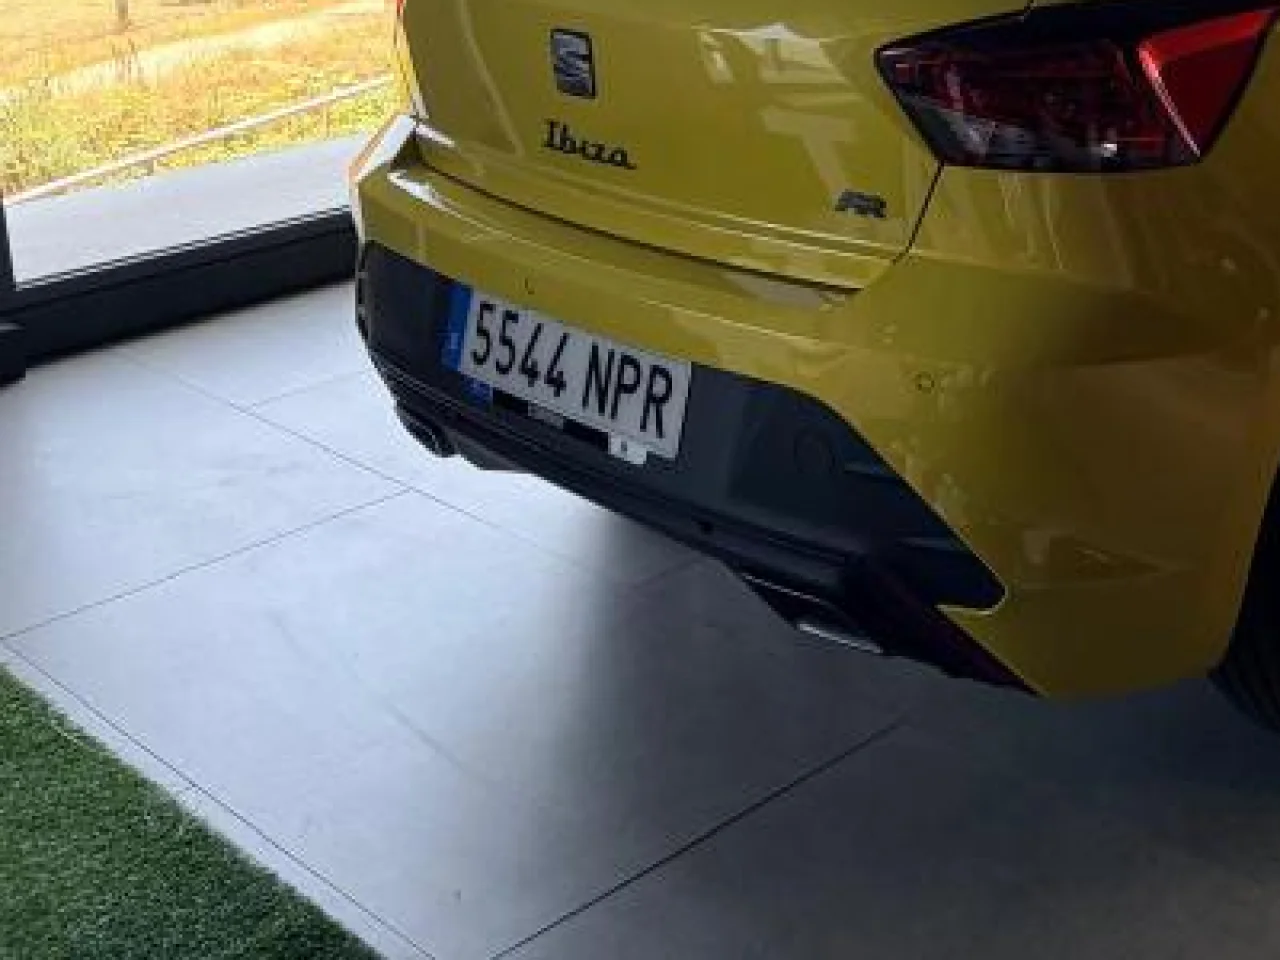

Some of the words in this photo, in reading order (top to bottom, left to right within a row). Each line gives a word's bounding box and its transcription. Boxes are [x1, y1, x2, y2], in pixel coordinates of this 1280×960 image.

[543, 119, 638, 170] Ibiza
[470, 300, 570, 398] 5544
[582, 341, 674, 439] NPR
